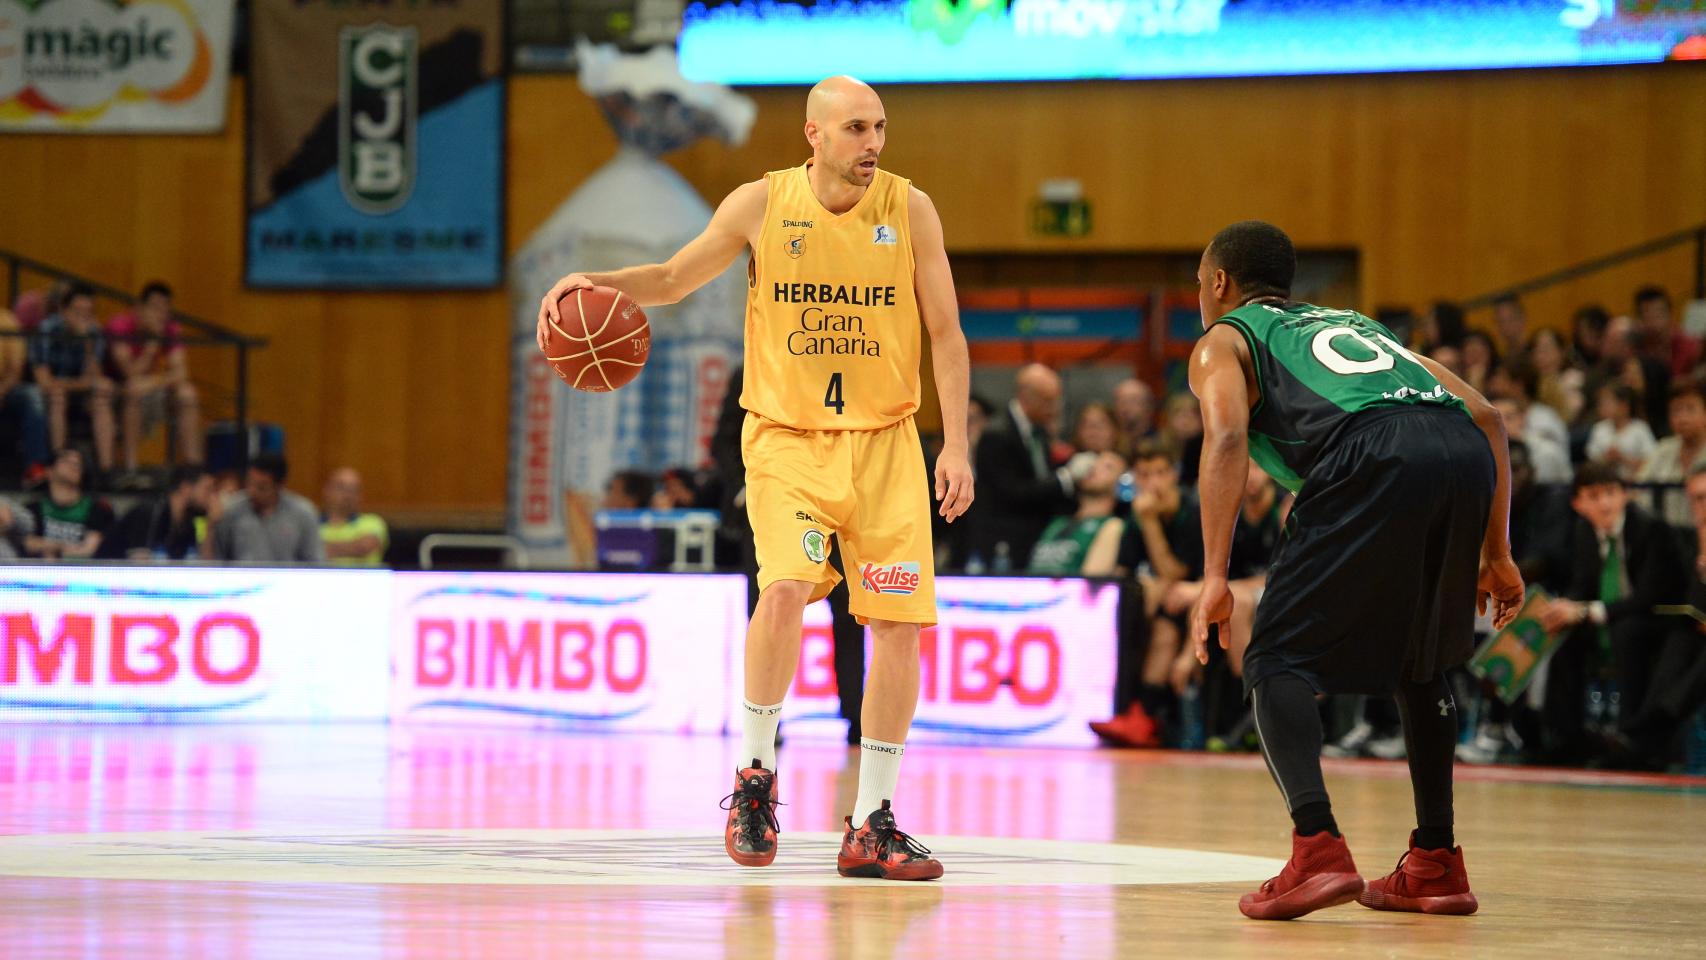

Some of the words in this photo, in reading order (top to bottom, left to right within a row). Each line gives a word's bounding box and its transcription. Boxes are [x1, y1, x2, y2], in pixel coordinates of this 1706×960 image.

[353, 32, 405, 192] CJB
[782, 219, 813, 229] SPALDING
[774, 282, 896, 307] HERBALIFE
[801, 307, 864, 333] Gran
[787, 331, 881, 358] Canaria
[824, 372, 845, 416] 4
[862, 562, 920, 594] Kalise
[415, 618, 648, 694] BIMBO
